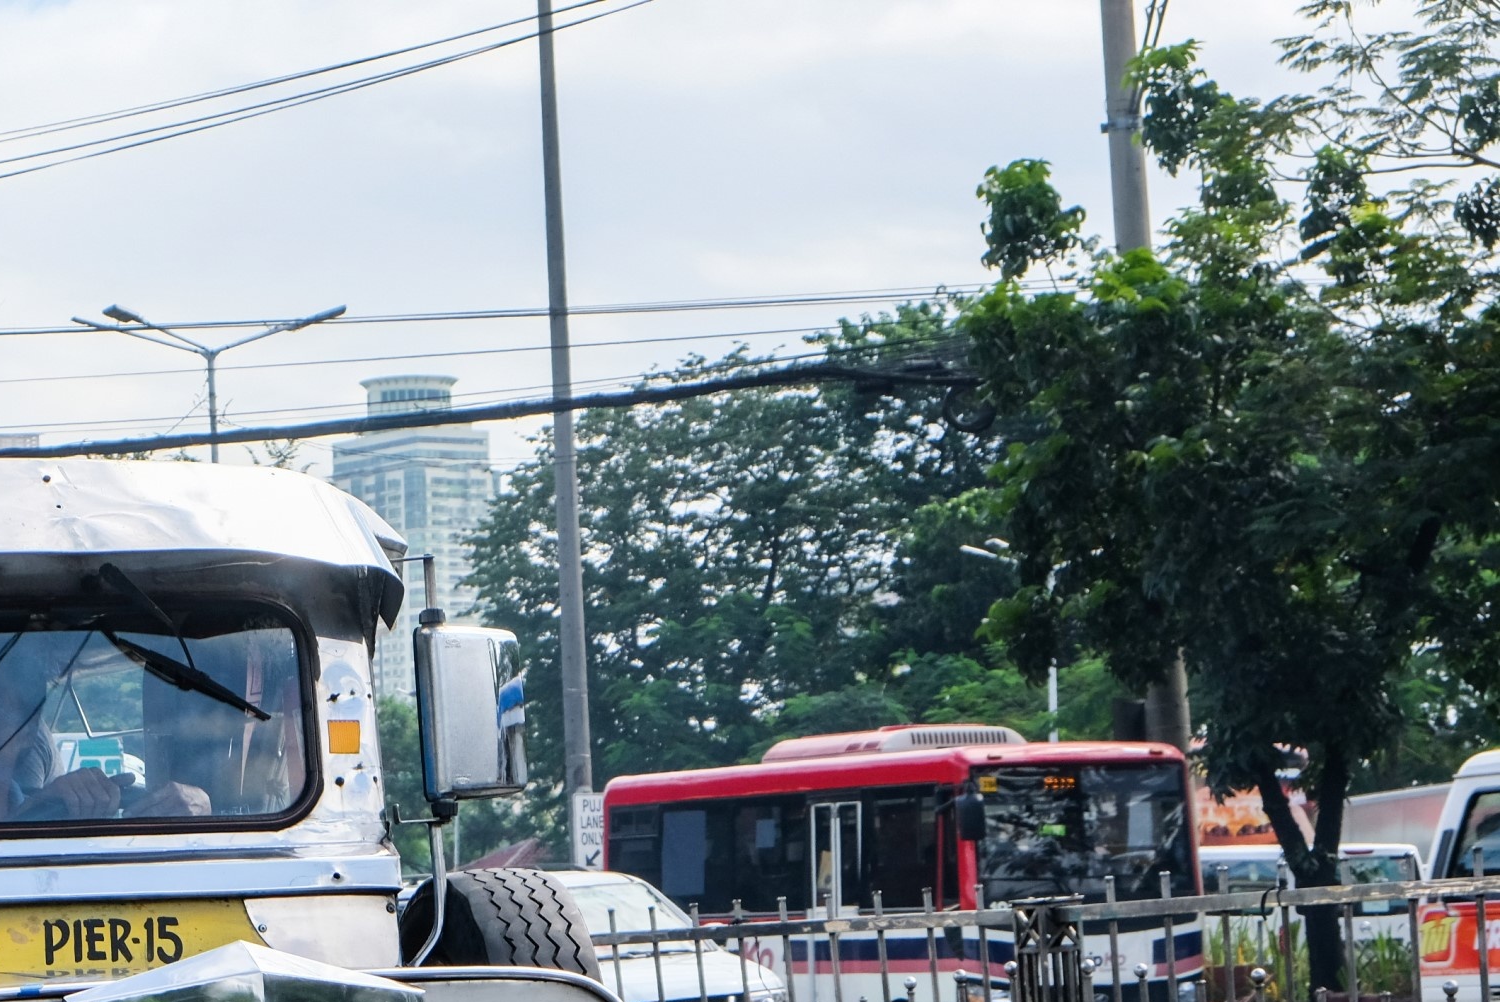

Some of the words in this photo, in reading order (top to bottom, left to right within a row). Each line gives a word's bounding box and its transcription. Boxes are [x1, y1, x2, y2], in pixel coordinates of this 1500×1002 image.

[582, 799, 602, 813] PUJ
[581, 815, 605, 829] LANE
[581, 832, 605, 846] ONLY
